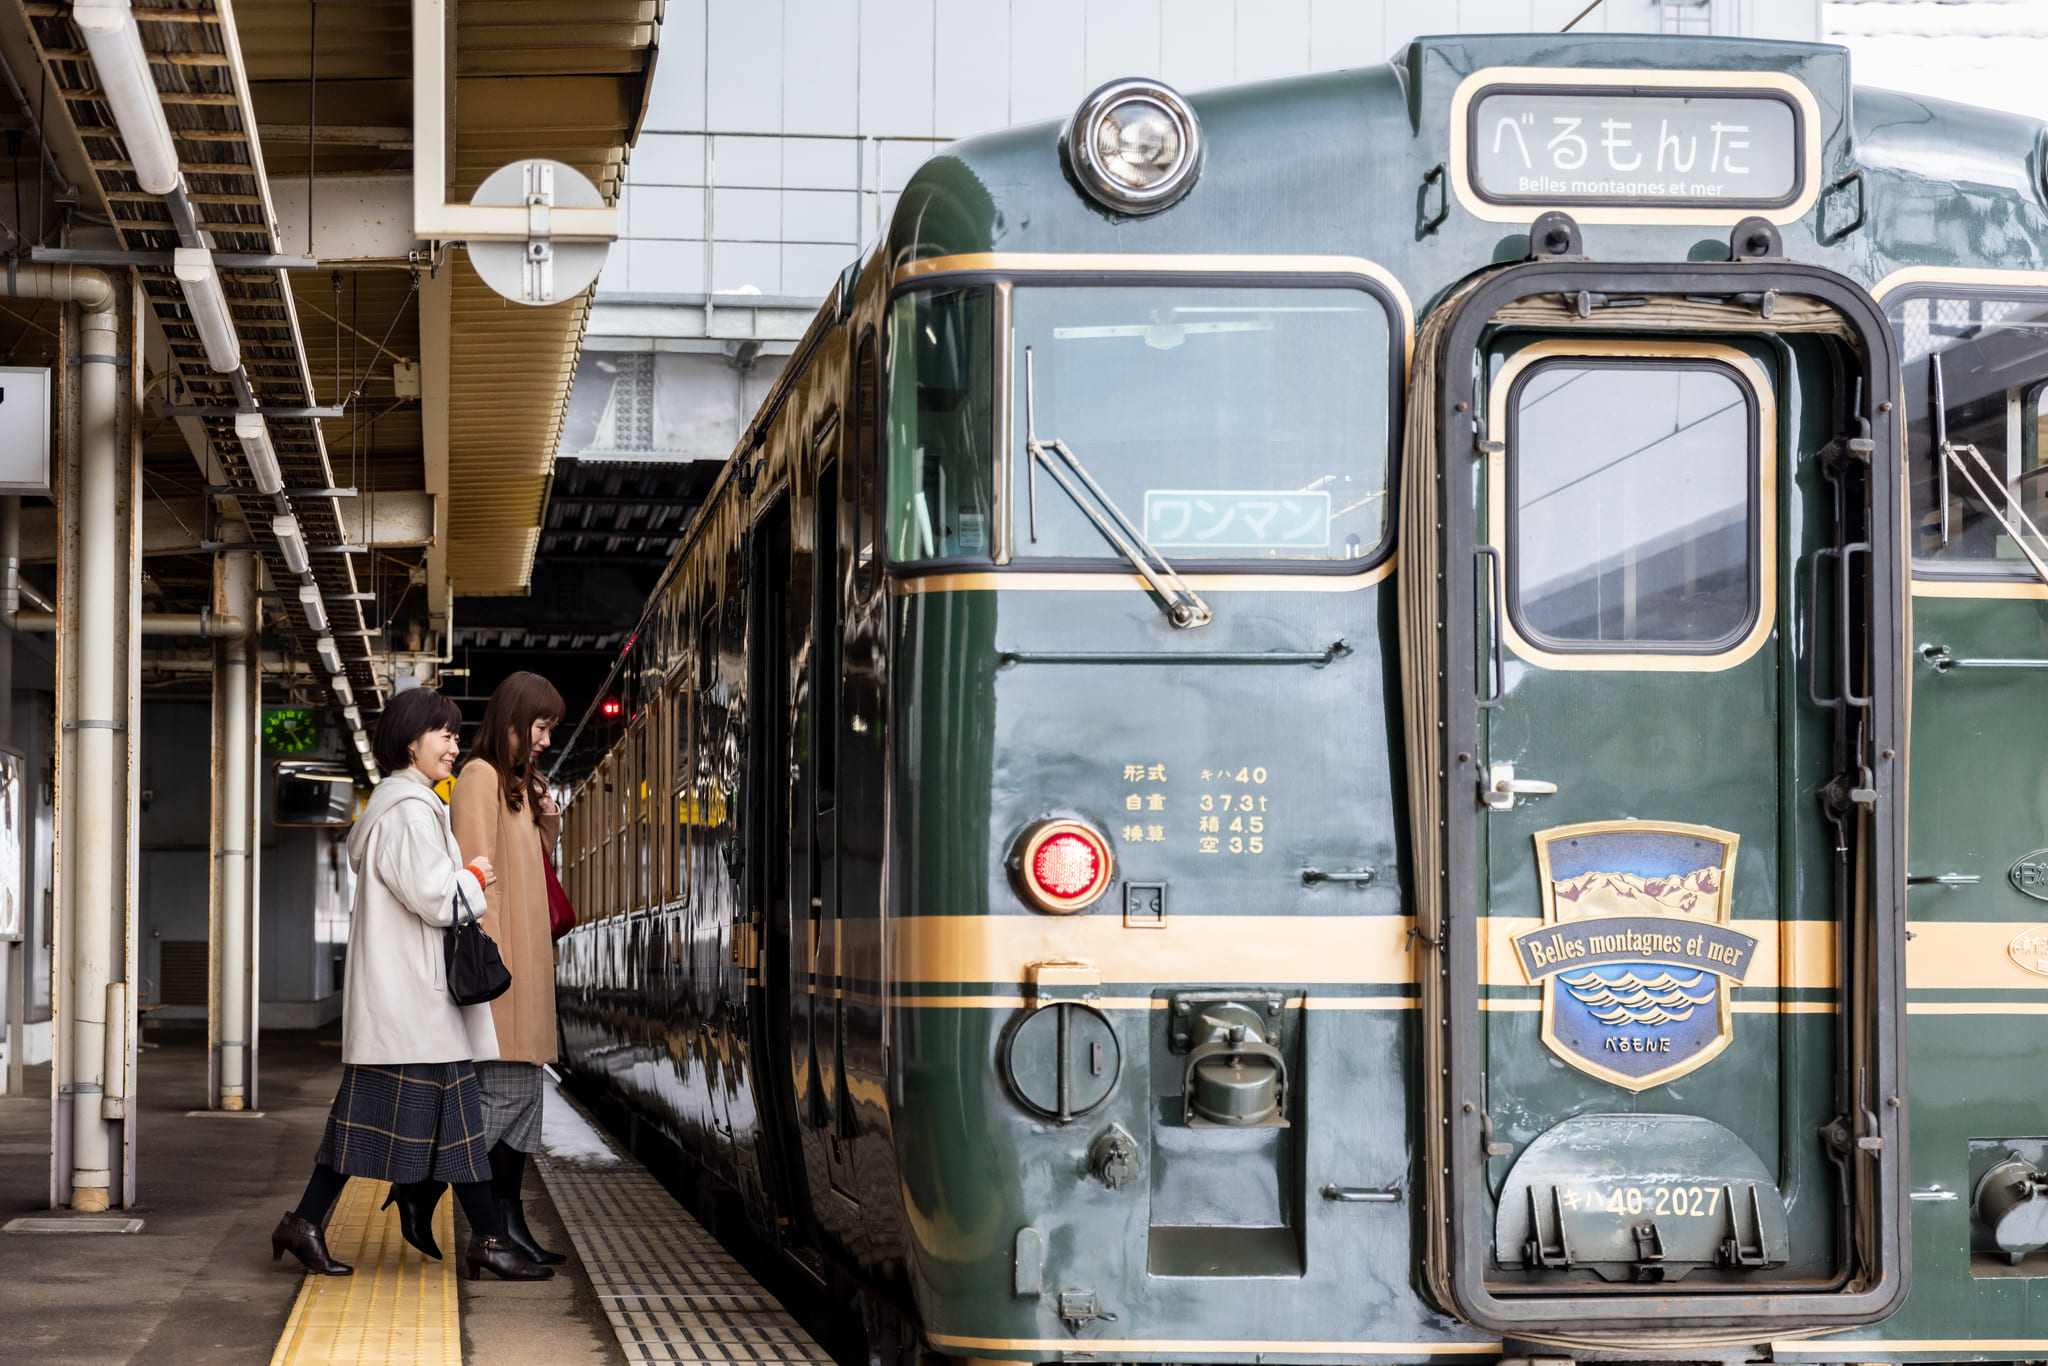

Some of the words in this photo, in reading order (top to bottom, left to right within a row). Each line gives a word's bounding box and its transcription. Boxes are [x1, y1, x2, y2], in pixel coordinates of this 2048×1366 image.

[1493, 113, 1750, 174] べるもんた
[1519, 176, 1567, 192] Belles
[1571, 178, 1665, 196] montagnes
[1669, 181, 1685, 195] et
[1691, 184, 1723, 196] mer
[1152, 500, 1323, 541] ワンマン
[1123, 763, 1167, 783] 形式
[1200, 766, 1268, 784] キハ40
[1125, 793, 1167, 811] 自重
[1200, 794, 1268, 812] 37.3t
[1122, 824, 1166, 843] 換算
[1200, 816, 1219, 833] 積
[1229, 816, 1264, 834] 4.5
[1199, 836, 1219, 853] 空
[1229, 836, 1264, 854] 3.5
[1528, 933, 1586, 969] Belles
[1589, 928, 1682, 956] montagnes
[1686, 935, 1704, 957] et
[1706, 941, 1743, 967] mer
[1605, 1036, 1671, 1052] べるもんた
[1563, 1187, 1643, 1216] キハ40
[1655, 1186, 1720, 1216] 2027
